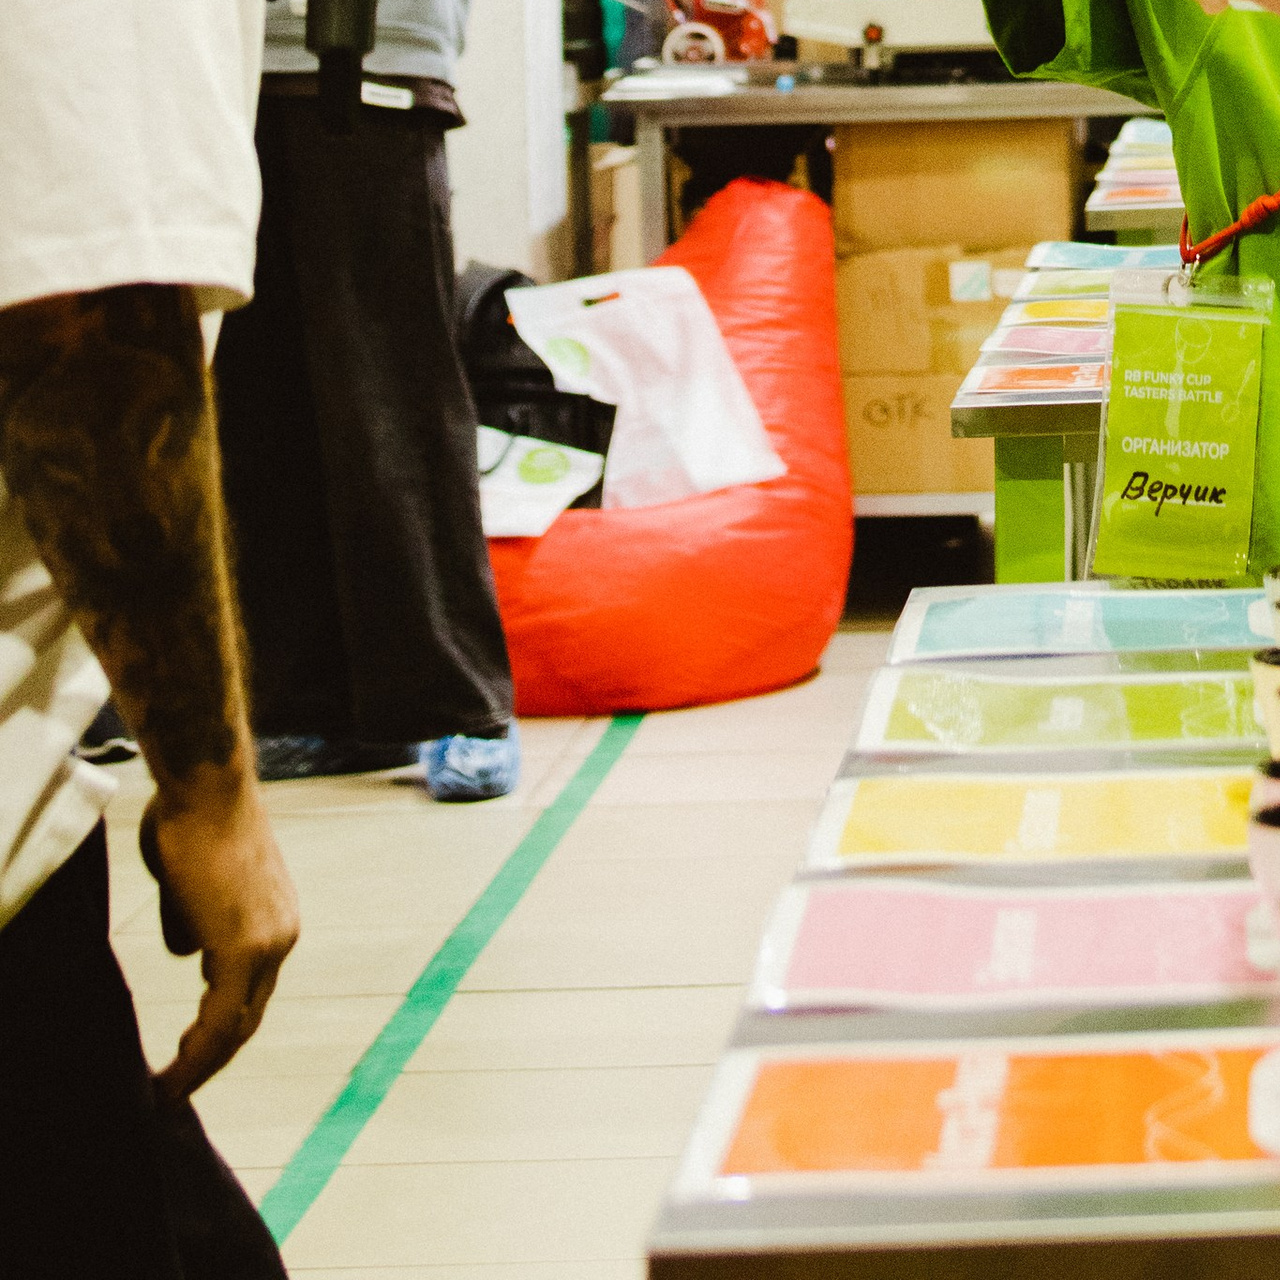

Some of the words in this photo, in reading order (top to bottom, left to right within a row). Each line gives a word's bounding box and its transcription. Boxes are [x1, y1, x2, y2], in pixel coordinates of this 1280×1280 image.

[1124, 370, 1141, 383] RB
[1144, 371, 1184, 385] FUNKY
[1186, 373, 1212, 386] CUP
[1124, 385, 1176, 400] TASTERS
[1178, 389, 1223, 404] BATTLE
[1121, 436, 1229, 460] ОРГАНИЗАТОР
[1121, 471, 1226, 517] Верчик
